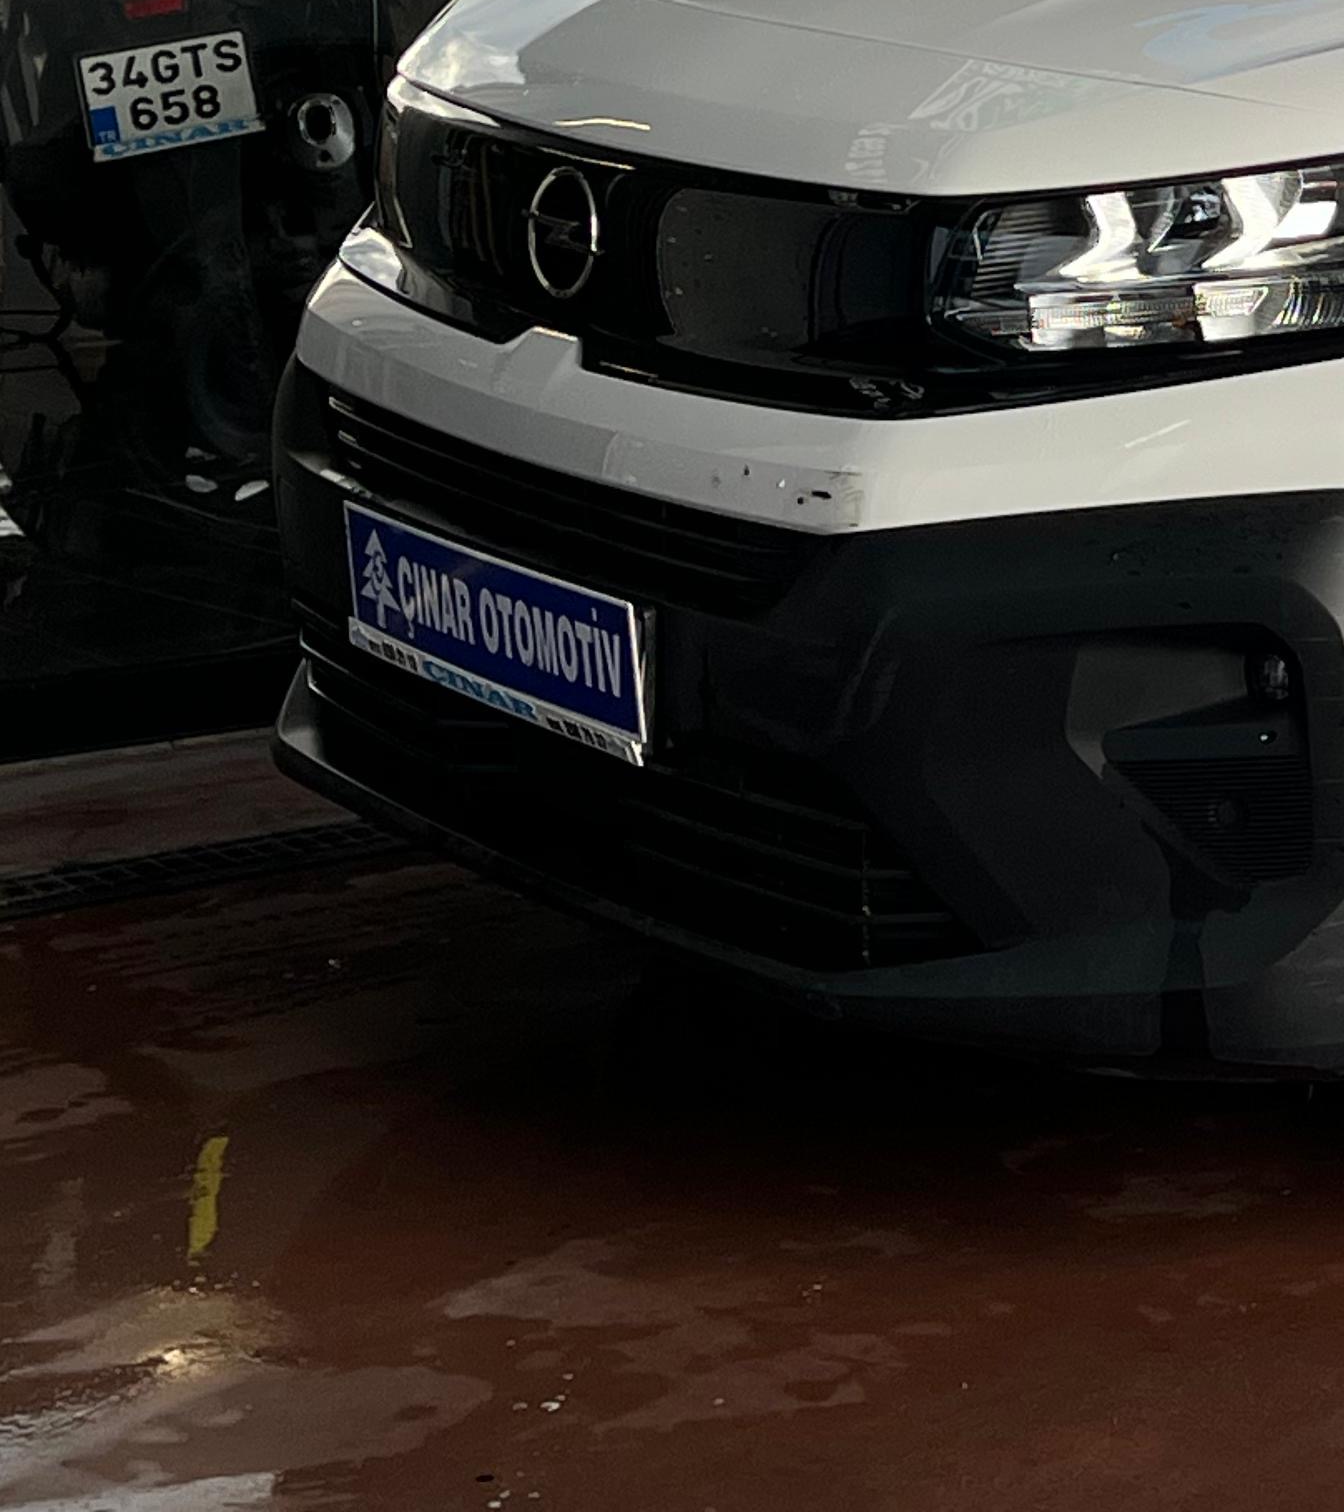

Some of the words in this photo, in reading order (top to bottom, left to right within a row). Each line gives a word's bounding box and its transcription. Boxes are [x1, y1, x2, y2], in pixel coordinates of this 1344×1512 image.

[88, 40, 242, 95] 34GTS
[129, 84, 221, 131] 658
[397, 556, 476, 645] ÇINAR
[480, 587, 621, 698] OTOMOTİV
